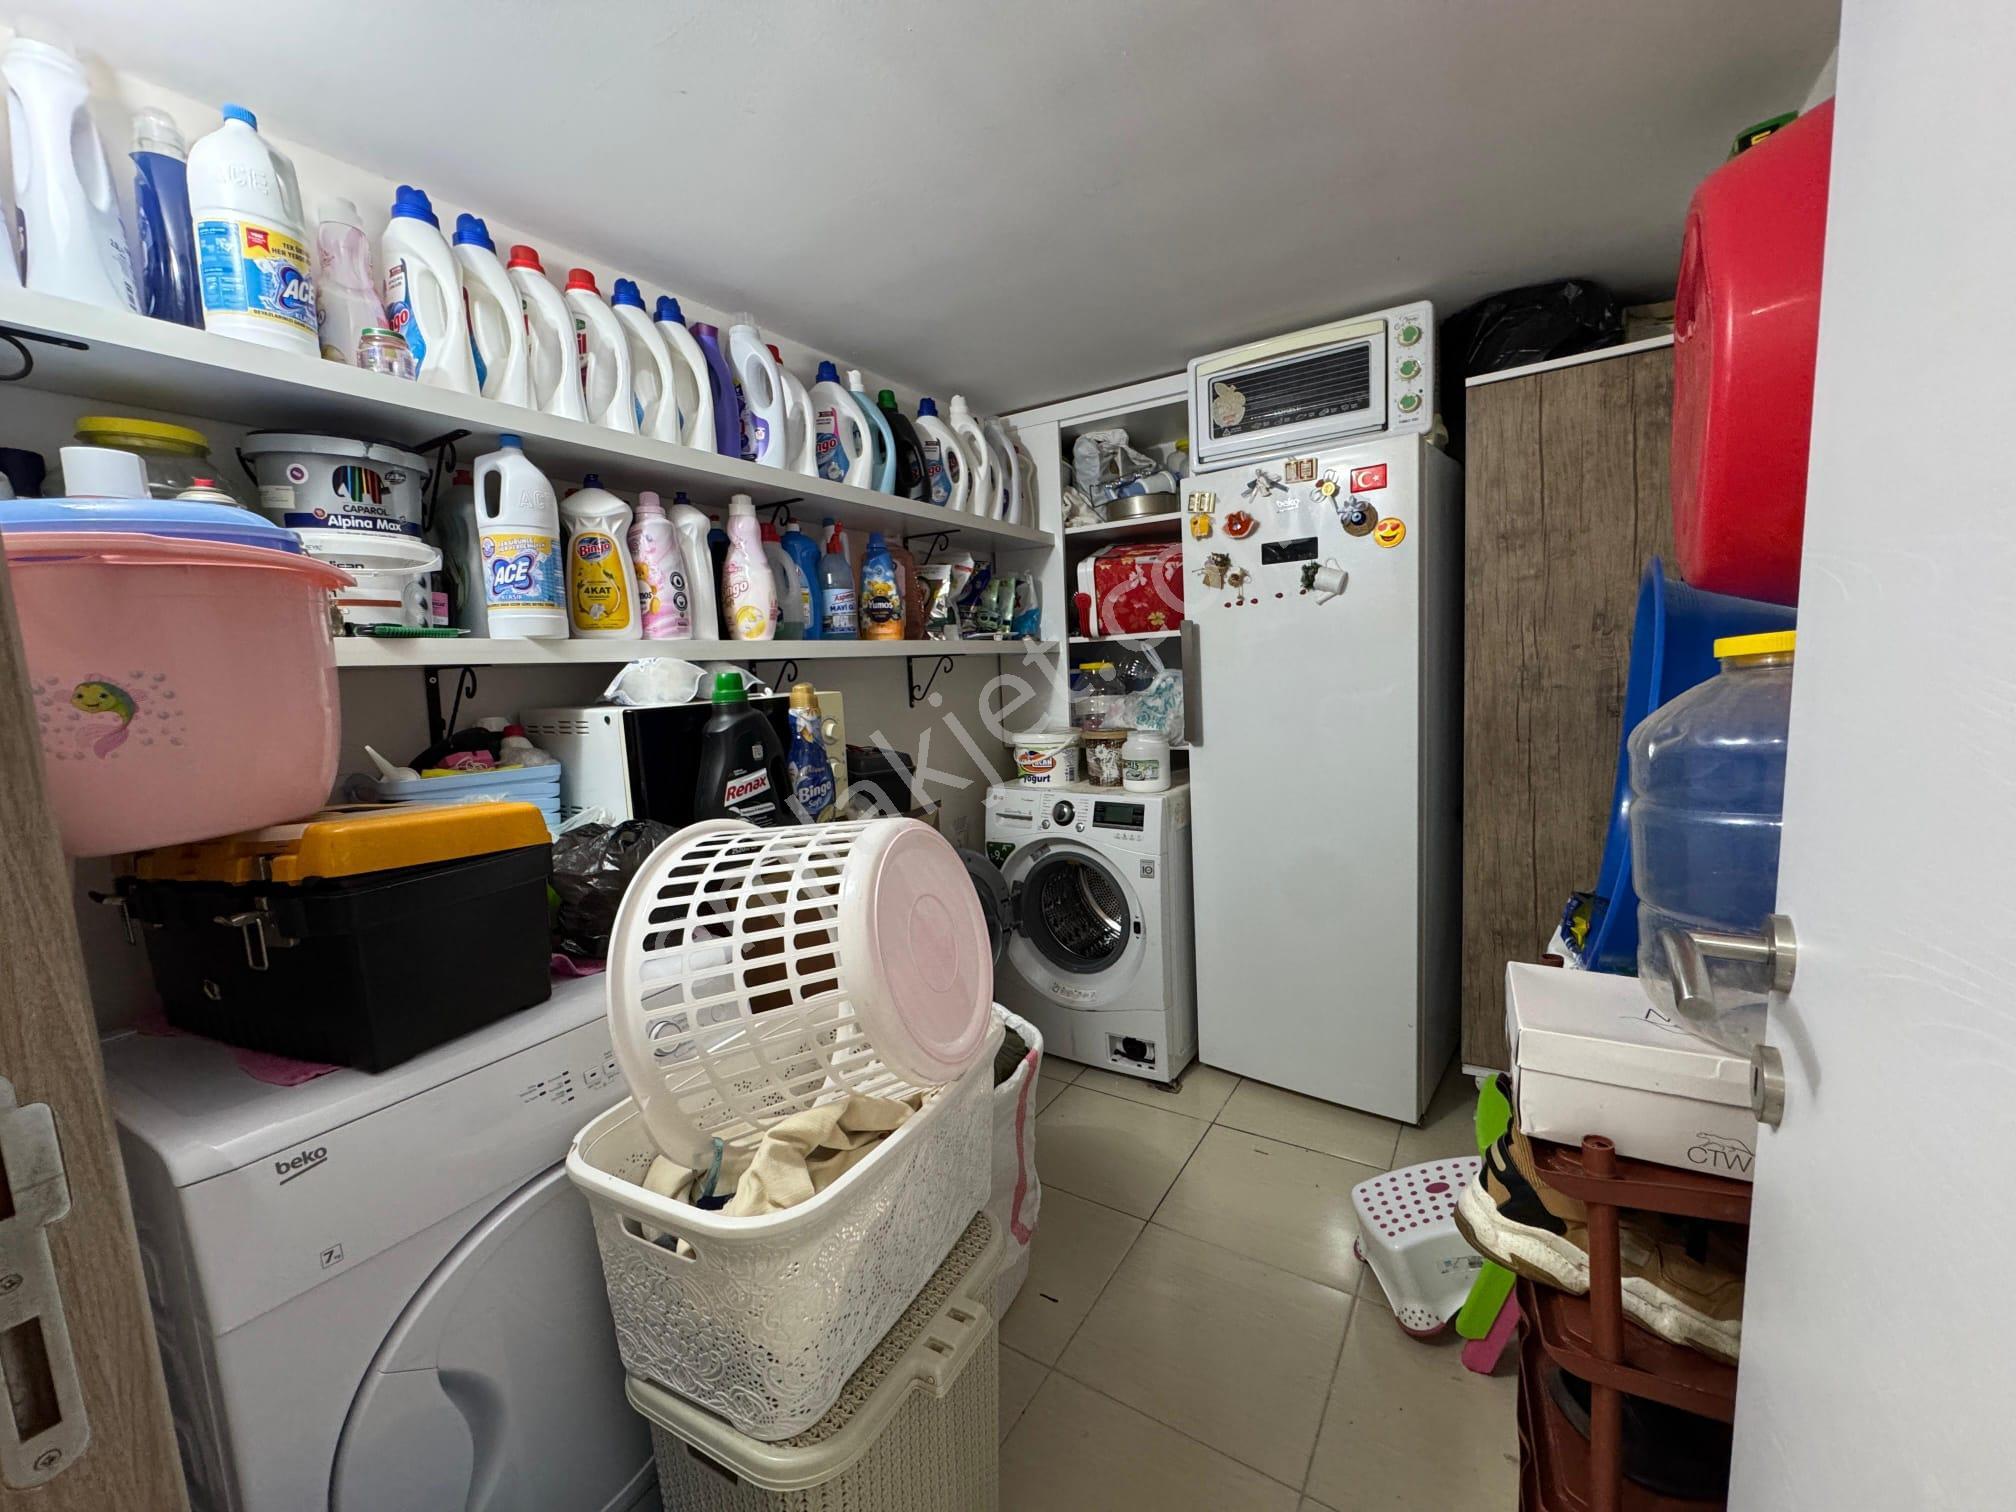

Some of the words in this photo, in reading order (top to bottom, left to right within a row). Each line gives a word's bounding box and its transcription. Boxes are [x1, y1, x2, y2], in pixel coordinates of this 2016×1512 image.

[342, 504, 390, 517] CAPAROL
[327, 514, 373, 530] Alpina
[376, 516, 402, 532] Max
[578, 541, 611, 557] Bingo
[494, 561, 530, 587] ACE
[868, 599, 894, 610] Yumos
[726, 776, 767, 802] Renax
[798, 781, 832, 804] Bingo
[274, 1146, 328, 1175] beko
[1686, 1146, 1753, 1174] CTW
